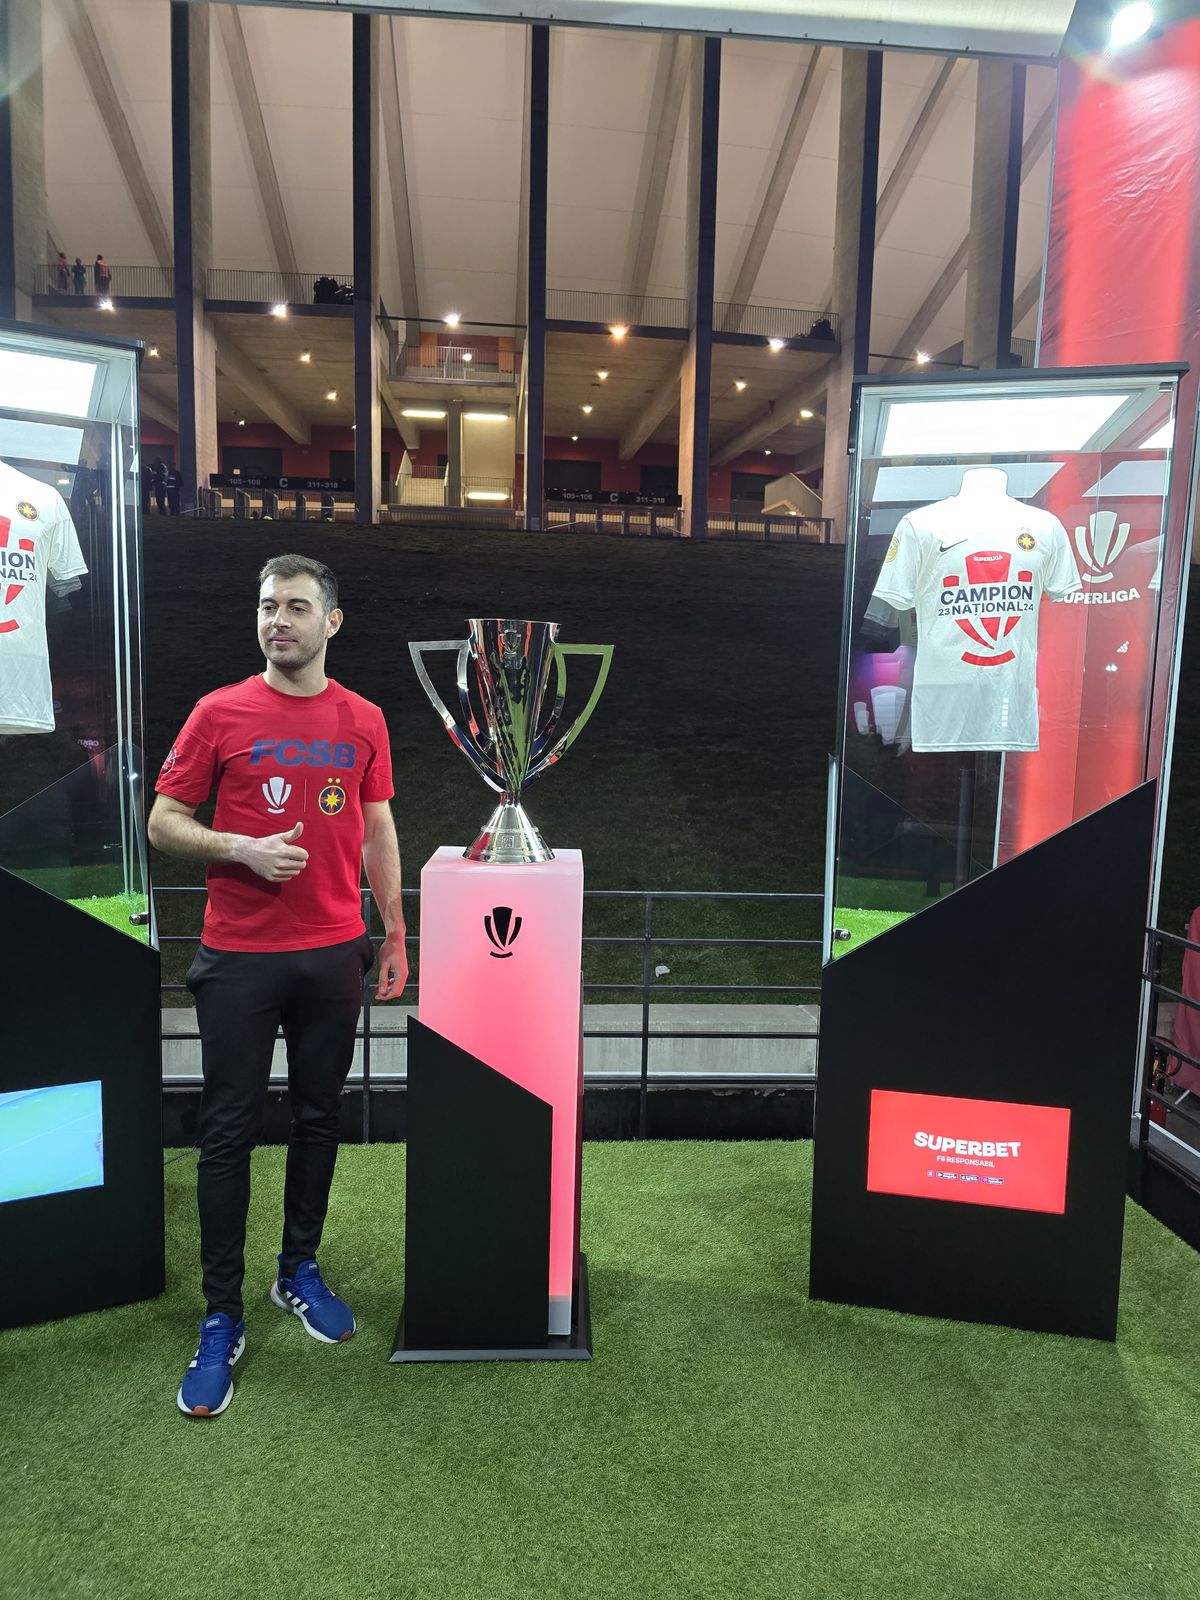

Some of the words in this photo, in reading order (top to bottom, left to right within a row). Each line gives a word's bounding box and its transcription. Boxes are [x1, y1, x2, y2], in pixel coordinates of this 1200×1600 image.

[279, 477, 288, 488] C
[609, 492, 618, 502] C
[940, 585, 1033, 605] CAMPION
[1054, 588, 1141, 604] UPERLIGA
[938, 607, 951, 616] 23
[1023, 603, 1034, 611] 24
[250, 739, 357, 769] FCSB
[913, 1131, 1021, 1157] SUPERBET
